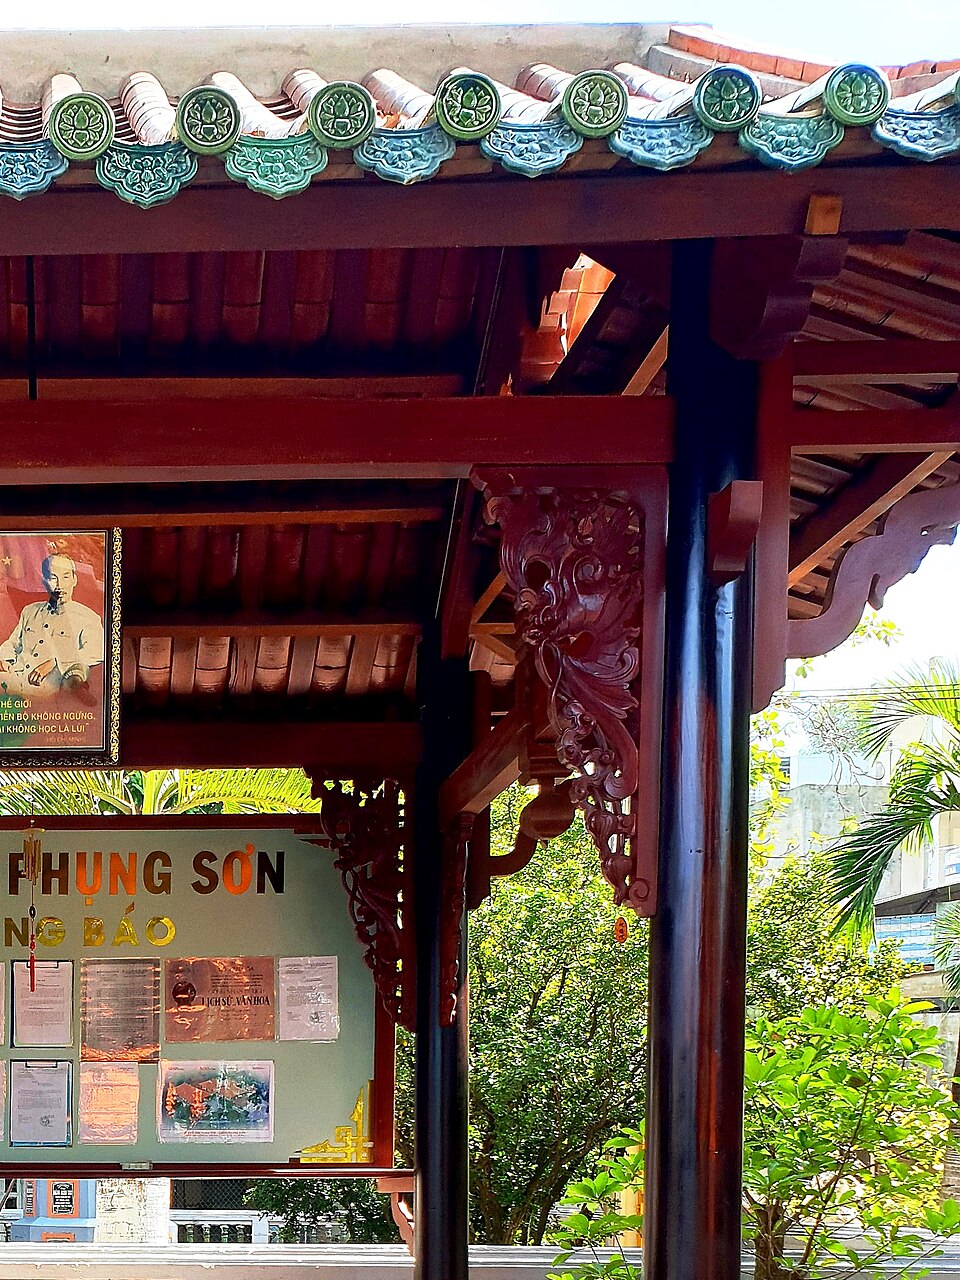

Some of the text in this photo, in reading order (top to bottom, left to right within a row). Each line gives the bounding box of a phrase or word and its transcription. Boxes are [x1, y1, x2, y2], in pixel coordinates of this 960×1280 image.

[6, 723, 37, 733] KHÔNG
[38, 725, 57, 734] HỌC
[58, 723, 70, 733] LÀ
[16, 711, 29, 722] BỘ
[31, 711, 61, 721] KHÔNG
[8, 850, 172, 906] PHỤNG
[191, 842, 285, 895] SƠN
[83, 902, 177, 947] BÁO
